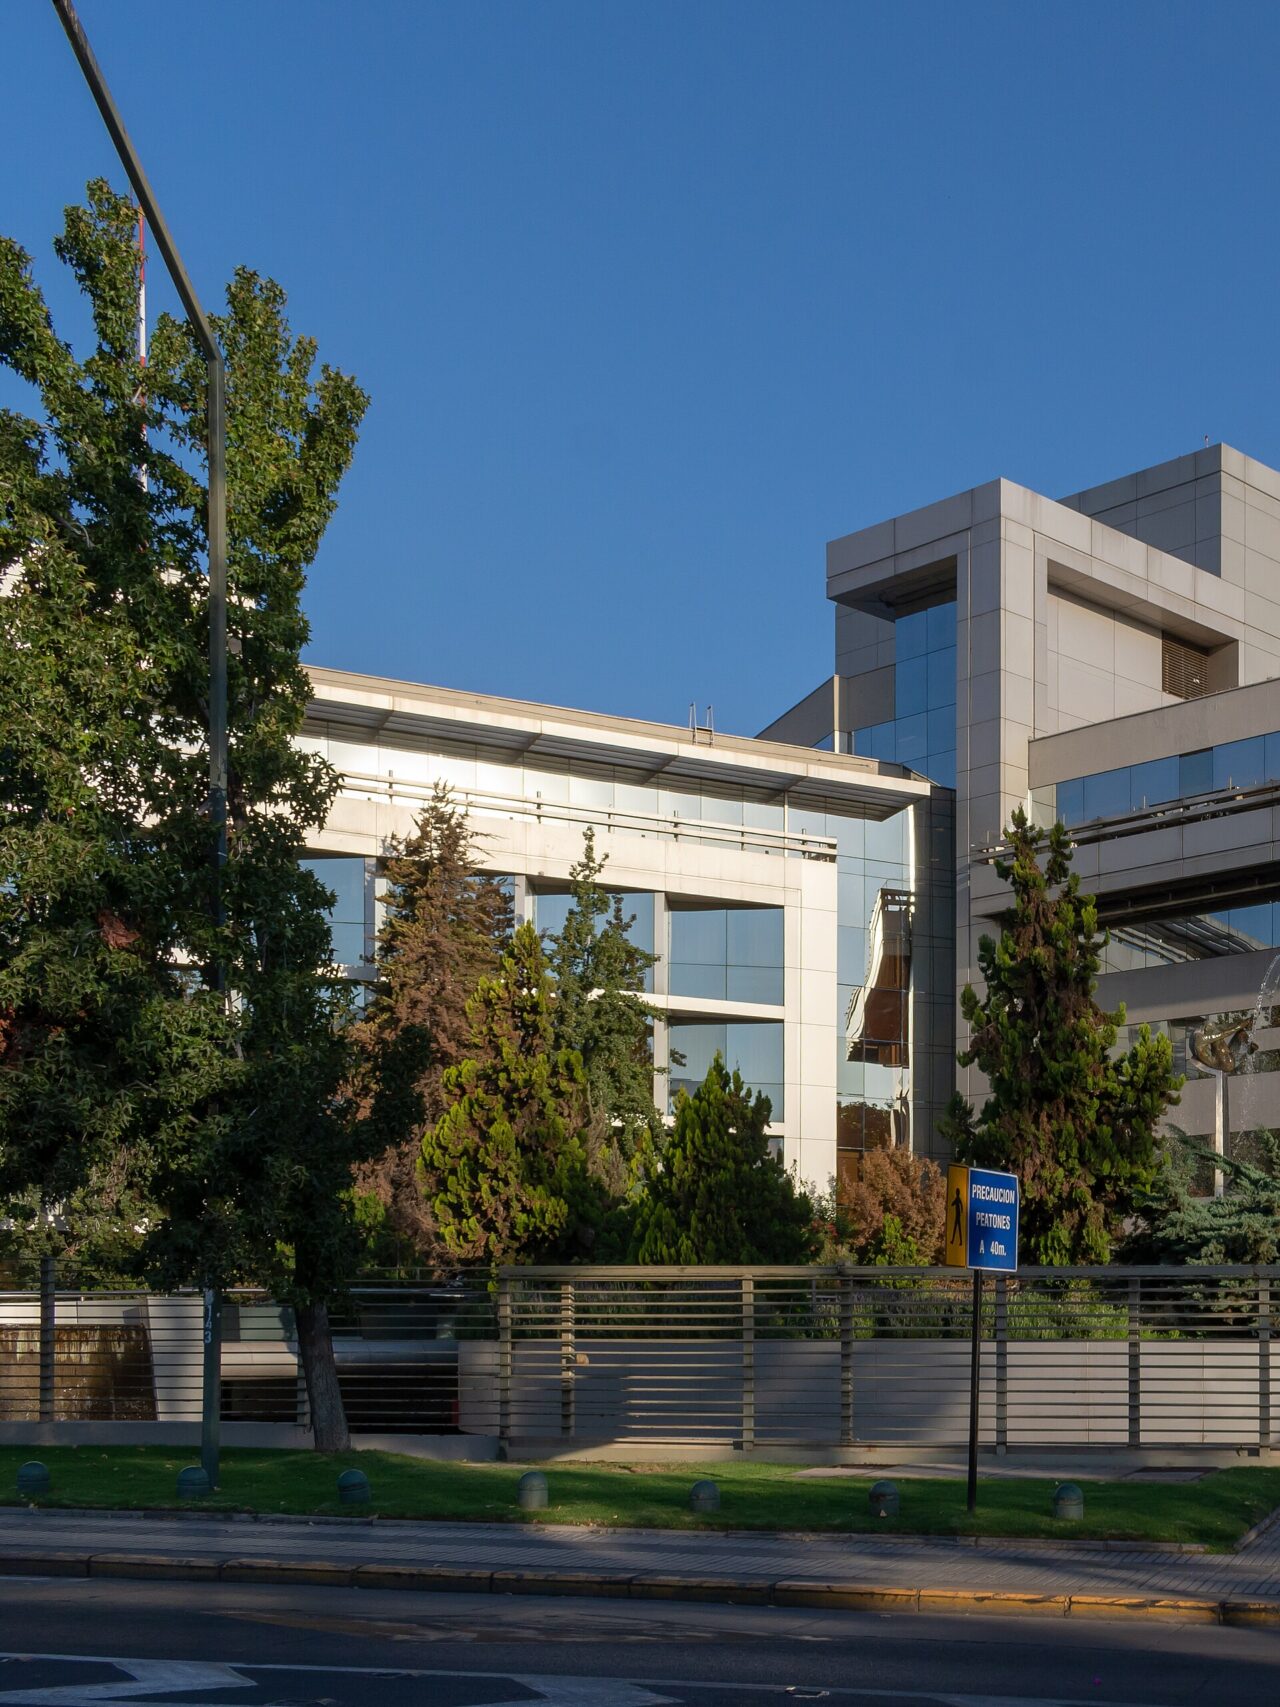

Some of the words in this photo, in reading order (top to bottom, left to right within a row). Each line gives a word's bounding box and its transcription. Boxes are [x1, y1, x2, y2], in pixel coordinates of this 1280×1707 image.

[972, 1184, 1015, 1203] PRECAUCION
[976, 1212, 1010, 1230] PEATONES
[979, 1239, 985, 1254] A
[990, 1241, 1007, 1256] 40m.
